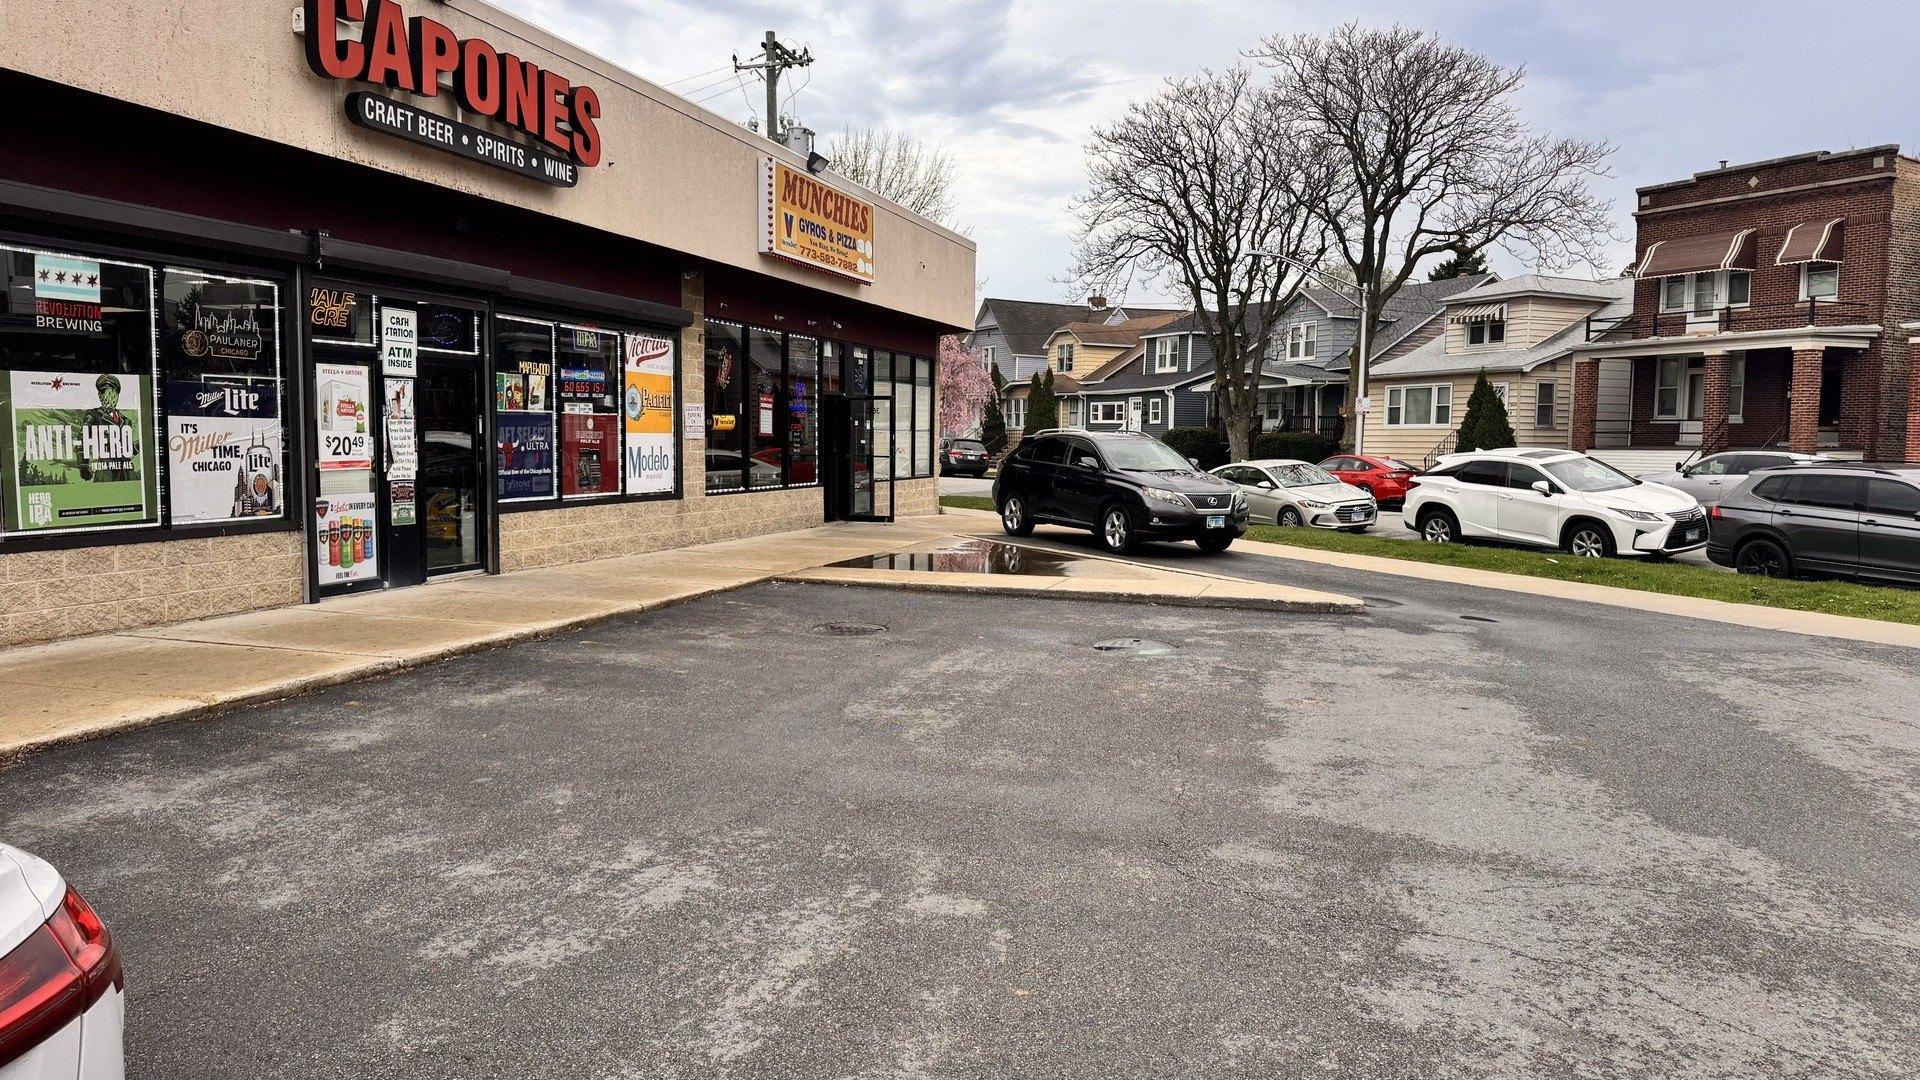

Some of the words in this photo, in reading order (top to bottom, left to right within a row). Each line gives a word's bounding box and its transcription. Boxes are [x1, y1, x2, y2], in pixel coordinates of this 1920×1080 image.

[310, 0, 601, 167] CAPONES
[364, 97, 413, 131] CRAFT
[418, 116, 454, 146] BEER
[476, 135, 525, 168] SPIRITS
[544, 157, 573, 183] WINE
[781, 169, 868, 234] MUNCHIES
[799, 217, 827, 241] GYROS
[829, 229, 835, 244] &
[836, 231, 858, 252] PIZZA
[36, 301, 102, 320] REVOLUTION
[36, 315, 103, 332] BREWING
[390, 316, 409, 326] CASH
[385, 327, 413, 338] STATION
[210, 334, 258, 348] PAULANER
[221, 348, 249, 356] CHICAGO
[388, 346, 412, 358] ATM
[388, 359, 412, 368] INSIDE
[519, 361, 550, 376] MAPLEWOOD
[196, 391, 224, 409] Miller
[223, 387, 259, 416] Lite
[180, 423, 198, 434] IT'S
[26, 424, 133, 461] ANTI-HERO
[170, 430, 233, 463] Miller
[526, 442, 549, 451] ULTRA
[211, 445, 244, 460] TIME,
[91, 461, 107, 471] INDIA
[108, 460, 121, 471] PALE
[123, 460, 133, 470] ALE
[192, 460, 232, 472] CHICAGO
[248, 453, 271, 473] Lite
[628, 445, 669, 478] Modelo
[28, 491, 51, 505] HERO
